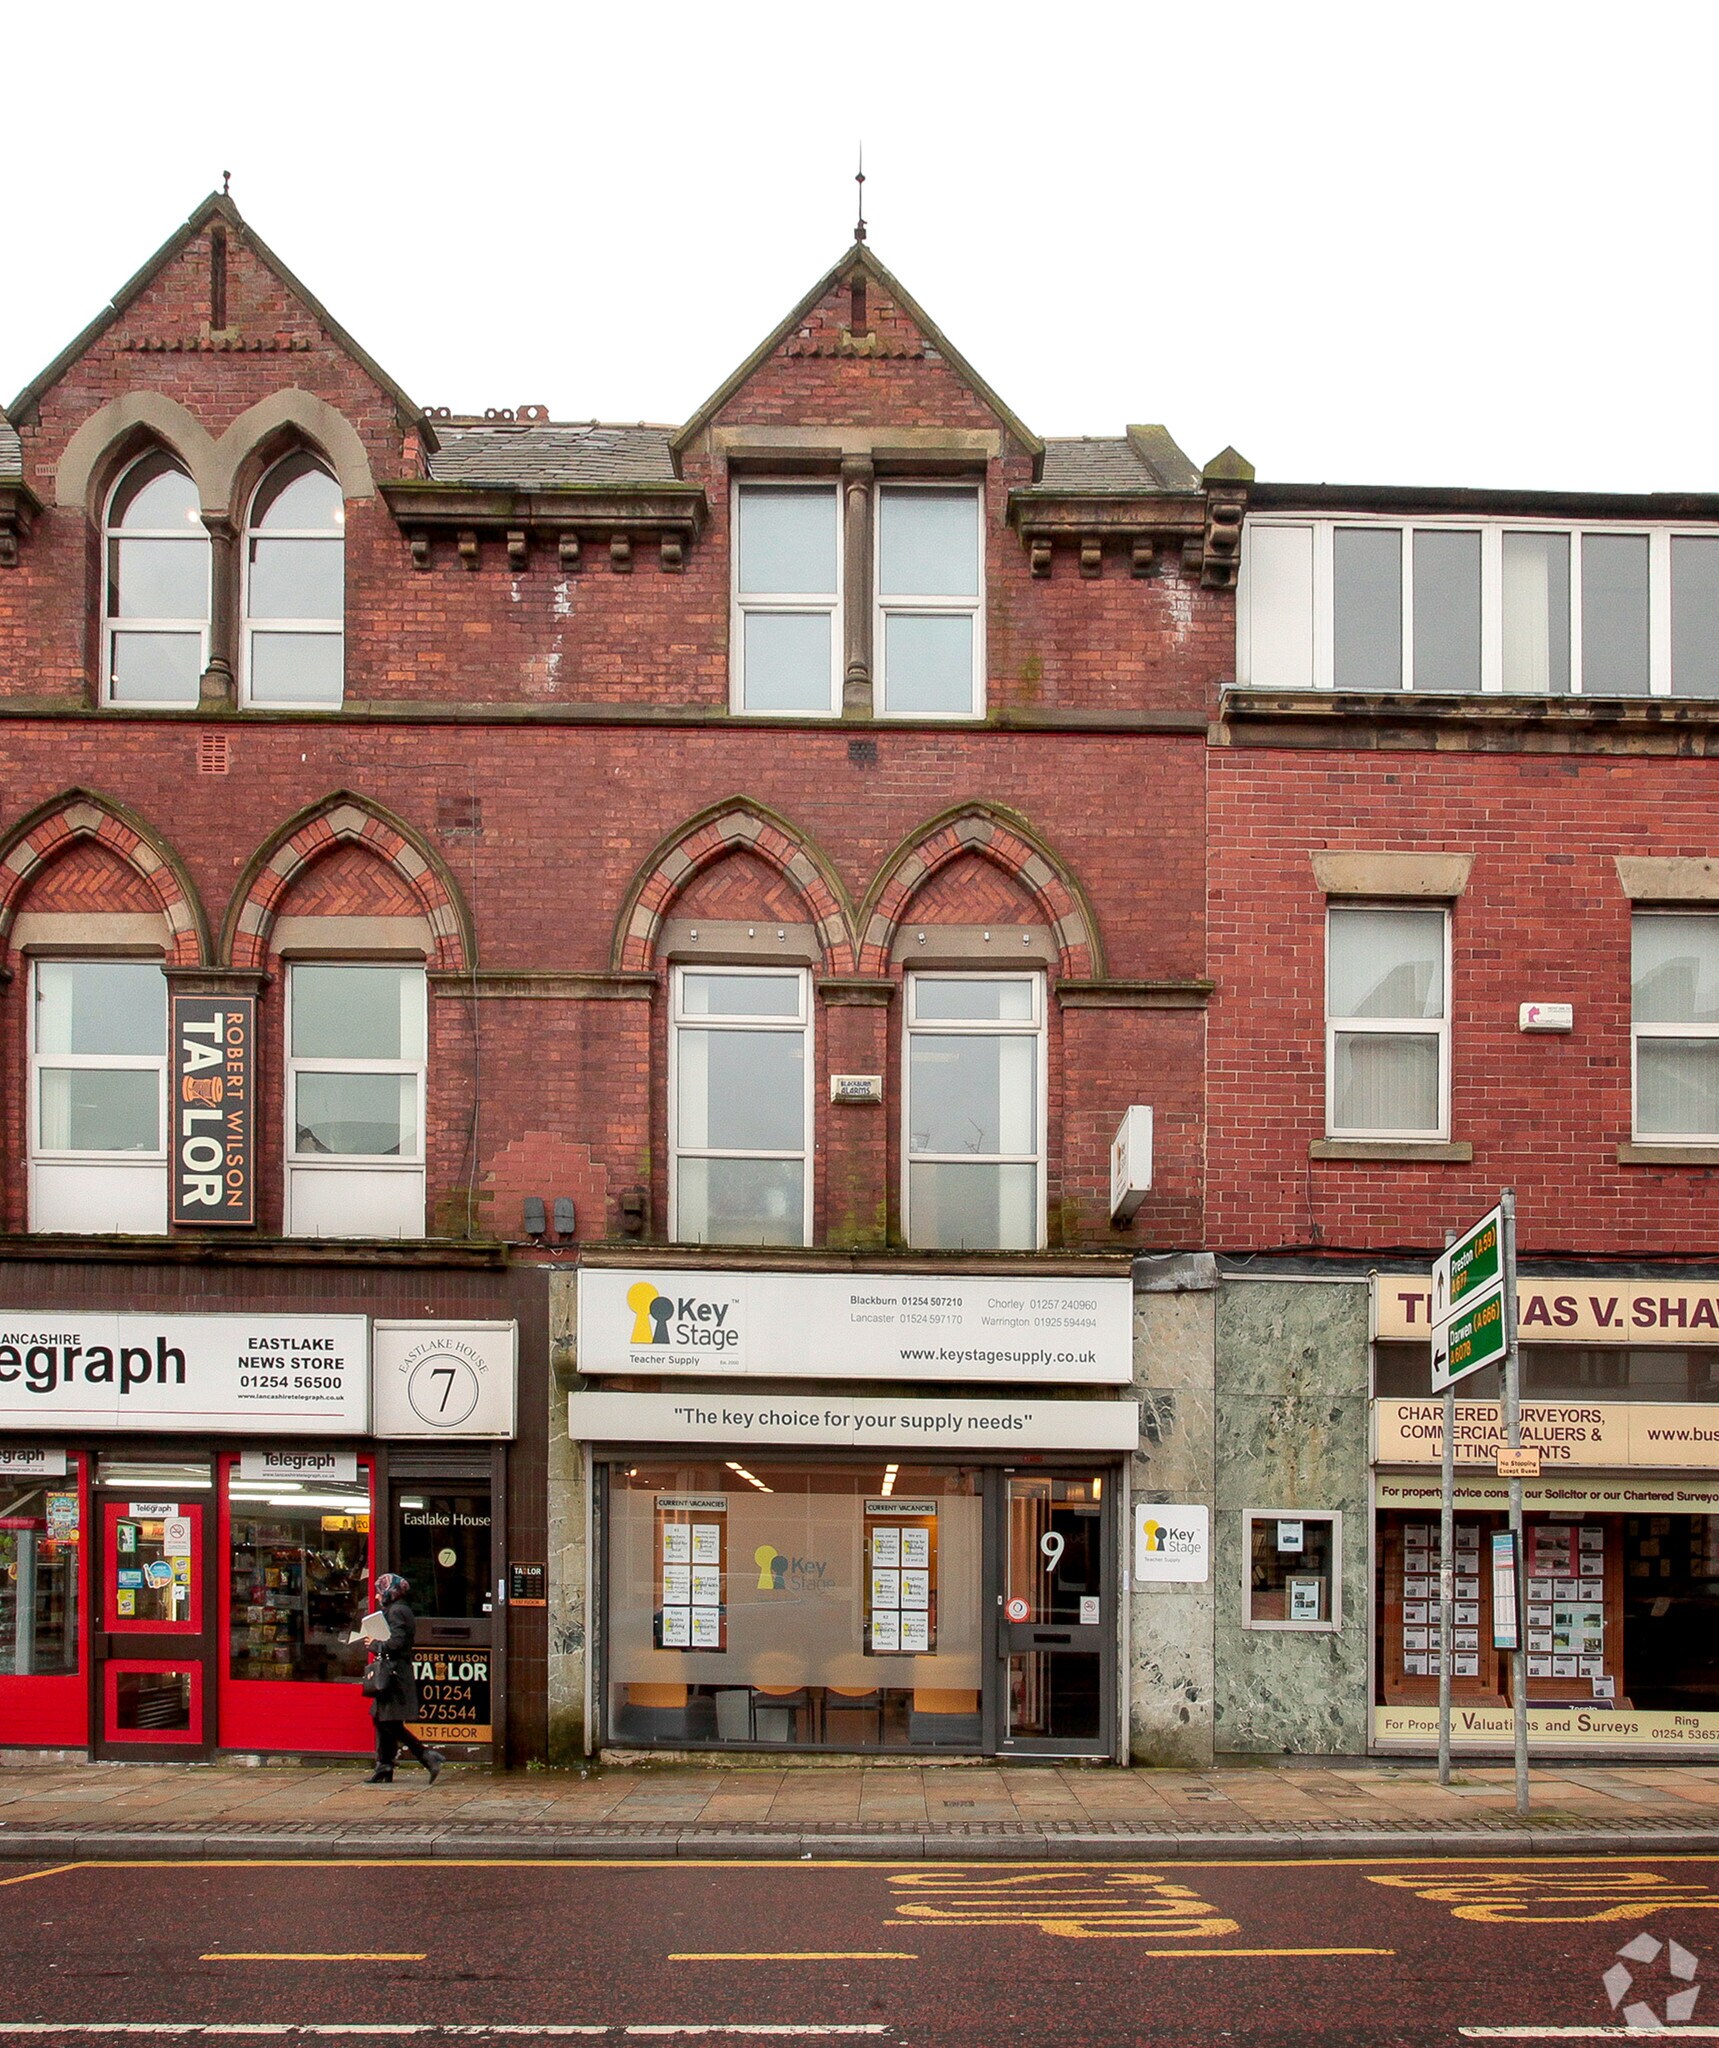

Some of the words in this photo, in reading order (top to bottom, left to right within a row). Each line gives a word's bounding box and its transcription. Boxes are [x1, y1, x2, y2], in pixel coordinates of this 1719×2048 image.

[226, 1013, 244, 1100] ROBERT
[226, 1110, 243, 1206] WILSON
[1451, 1249, 1474, 1276] Preston
[1474, 1226, 1496, 1259] (A59)
[1451, 1270, 1468, 1295] A677
[850, 1296, 897, 1306] Blackburn
[901, 1297, 929, 1306] 01254
[930, 1297, 963, 1307] 507210
[987, 1298, 1025, 1310] Chorley
[1029, 1300, 1059, 1310] 01257
[1061, 1300, 1097, 1311] 240960
[677, 1298, 729, 1327] Key
[1398, 1293, 1578, 1327] TAS
[1589, 1297, 1623, 1327] V.
[1632, 1297, 1719, 1328] SHA
[850, 1313, 895, 1323] Lancaster
[900, 1314, 928, 1324] 01524
[929, 1314, 963, 1325] 597170
[981, 1316, 1030, 1329] Warrington
[1034, 1317, 1062, 1327] 01925
[1063, 1318, 1097, 1328] 594494
[1450, 1323, 1473, 1346] Darwen
[1473, 1300, 1499, 1332] (A666)
[0, 1333, 81, 1345] ANCASHIRE
[248, 1337, 334, 1350] EASTLAKE
[676, 1324, 739, 1350] Stage
[398, 1338, 453, 1374] EASTLAKE
[455, 1341, 490, 1375] HOUSE
[630, 1355, 665, 1364] Teacher
[668, 1356, 700, 1366] Supply
[900, 1348, 1096, 1365] www.keystagesupply.co.uk
[1450, 1340, 1472, 1366] A6078
[238, 1357, 285, 1369] NEWS
[290, 1358, 344, 1370] STORE
[240, 1375, 288, 1388] 01254
[293, 1376, 342, 1389] 56500
[430, 1368, 456, 1412] 7
[674, 1408, 718, 1424] "The
[722, 1409, 754, 1428] key
[758, 1410, 820, 1426] choice
[824, 1411, 850, 1426] for
[854, 1415, 896, 1428] your
[900, 1413, 963, 1432] supply
[967, 1414, 1033, 1430] needs"
[1398, 1406, 1498, 1421] CHARERED
[1518, 1408, 1605, 1425] URVEYORS,
[1591, 1428, 1602, 1441] &
[0, 1449, 45, 1464] graph
[1432, 1444, 1501, 1459] LTTING
[263, 1453, 335, 1469] Telegraph
[1382, 1486, 1399, 1496] For
[1402, 1488, 1442, 1499] property
[1452, 1488, 1482, 1498] dvice
[1525, 1491, 1542, 1499] our
[1545, 1488, 1587, 1499] Solicitor
[1590, 1492, 1601, 1500] or
[1603, 1492, 1621, 1500] our
[1623, 1490, 1674, 1500] Chartered
[1677, 1491, 1719, 1503] Surveyo
[136, 1504, 172, 1513] Telegraph
[689, 1500, 725, 1508] VACANCIES
[404, 1512, 450, 1526] Eastlake
[453, 1513, 491, 1526] House
[1169, 1528, 1195, 1543] Key
[1040, 1531, 1065, 1572] 9
[1169, 1541, 1201, 1555] Stage
[443, 1551, 452, 1565] 7
[791, 1557, 827, 1578] Key
[791, 1576, 836, 1594] Stage
[414, 1653, 444, 1662] OBERT
[448, 1654, 487, 1662] WILSON
[423, 1685, 472, 1700] 01254
[419, 1704, 476, 1720] 675544
[1385, 1719, 1404, 1729] For
[1408, 1720, 1457, 1732] Propey
[1462, 1712, 1539, 1731] Valuatins
[1545, 1720, 1571, 1732] and
[1577, 1714, 1639, 1735] Surveys
[1674, 1716, 1699, 1728] Ring
[420, 1726, 438, 1737] 1ST
[441, 1727, 478, 1738] FLOOR
[1652, 1729, 1684, 1739] 01254
